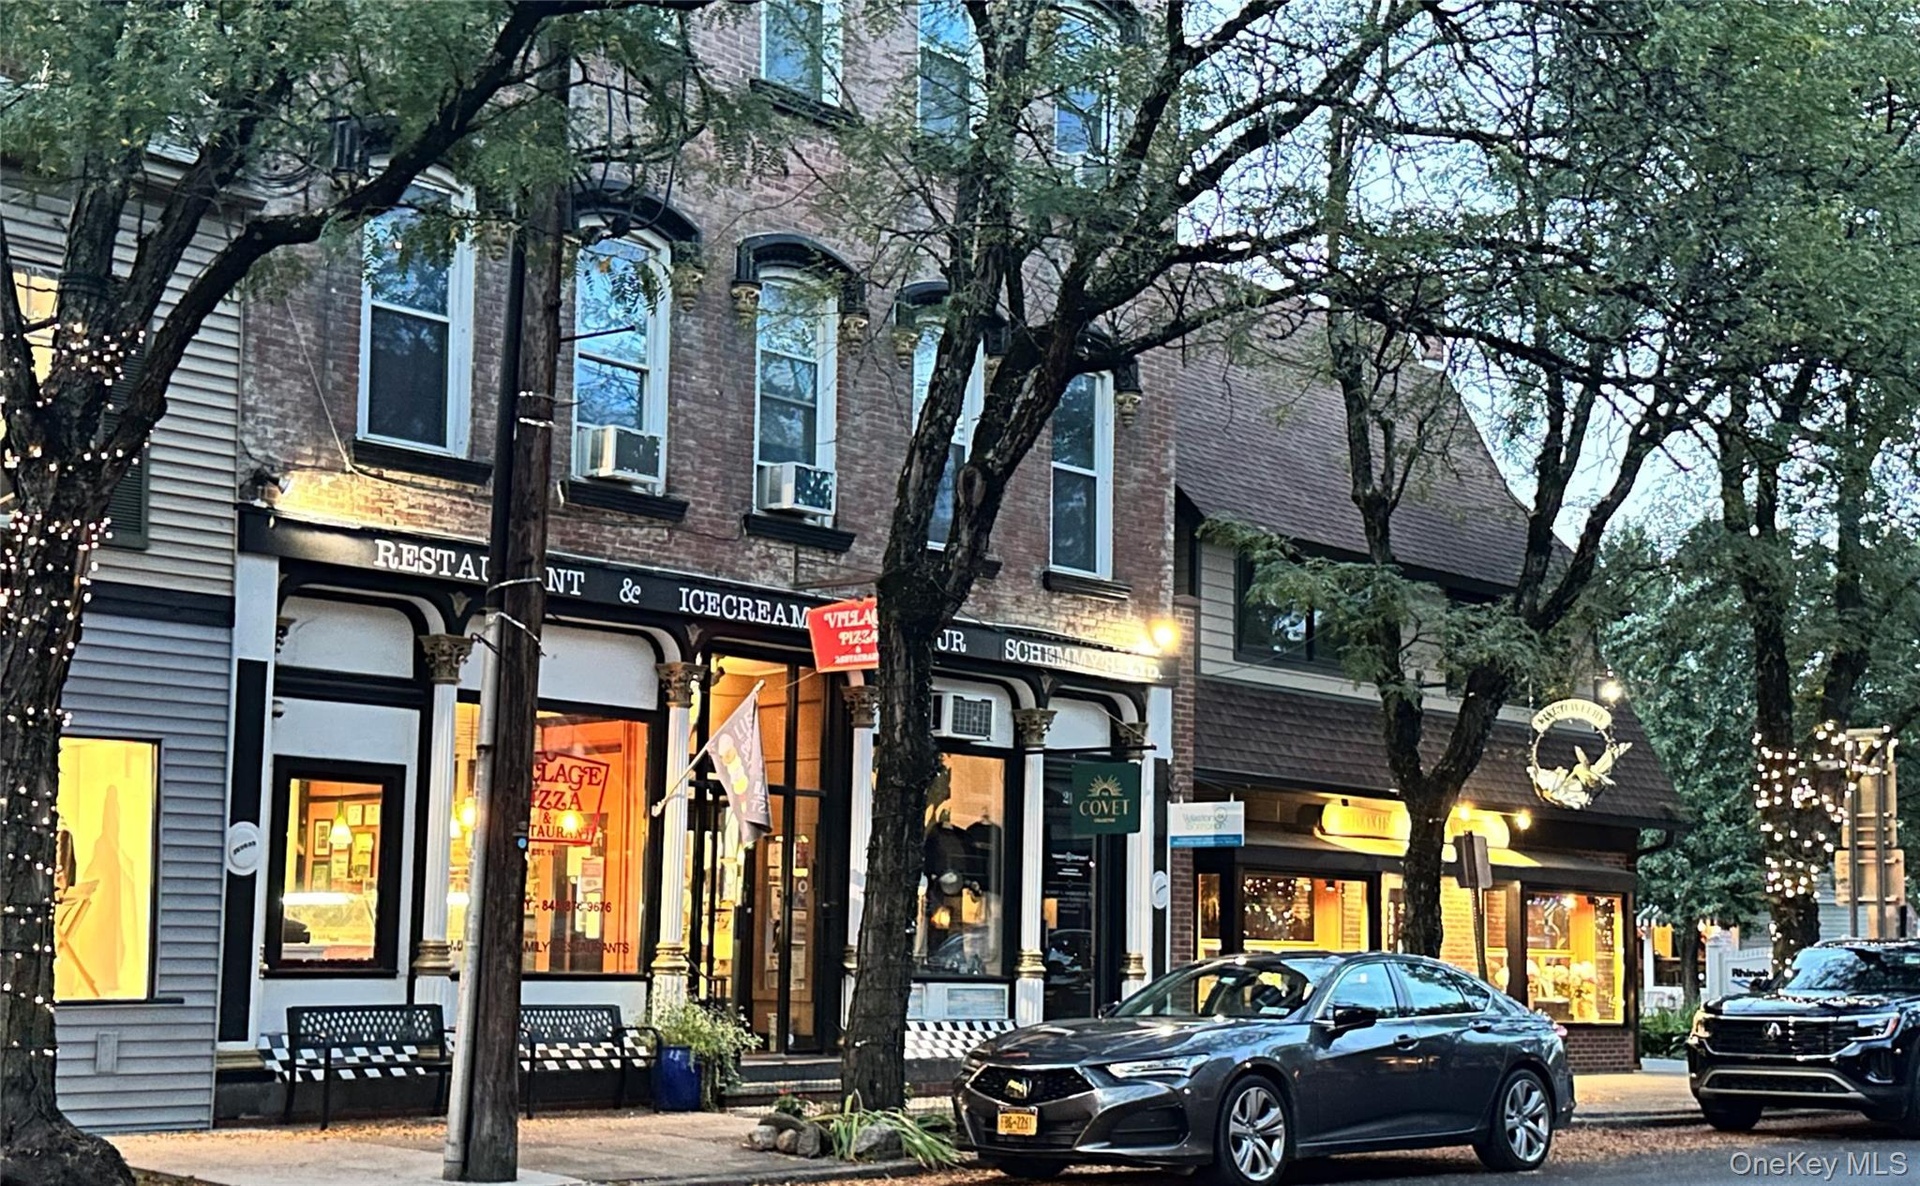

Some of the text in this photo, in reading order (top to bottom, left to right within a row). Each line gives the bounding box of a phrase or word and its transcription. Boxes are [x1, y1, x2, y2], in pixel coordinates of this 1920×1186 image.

[374, 539, 585, 596] RESTAUNT
[619, 578, 642, 604] &
[678, 587, 810, 629] ICECREAM
[1004, 637, 1118, 673] SCHEMMYS
[823, 608, 879, 629] VILLAG
[838, 630, 879, 645] PIZZA
[533, 763, 602, 791] LAGE
[531, 789, 583, 812] IZZA
[1079, 798, 1130, 816] COVET
[543, 811, 552, 824] &
[530, 824, 592, 841] TAURANT
[522, 941, 630, 954] MILY STAURANTS
[1731, 967, 1770, 977] Rhineb
